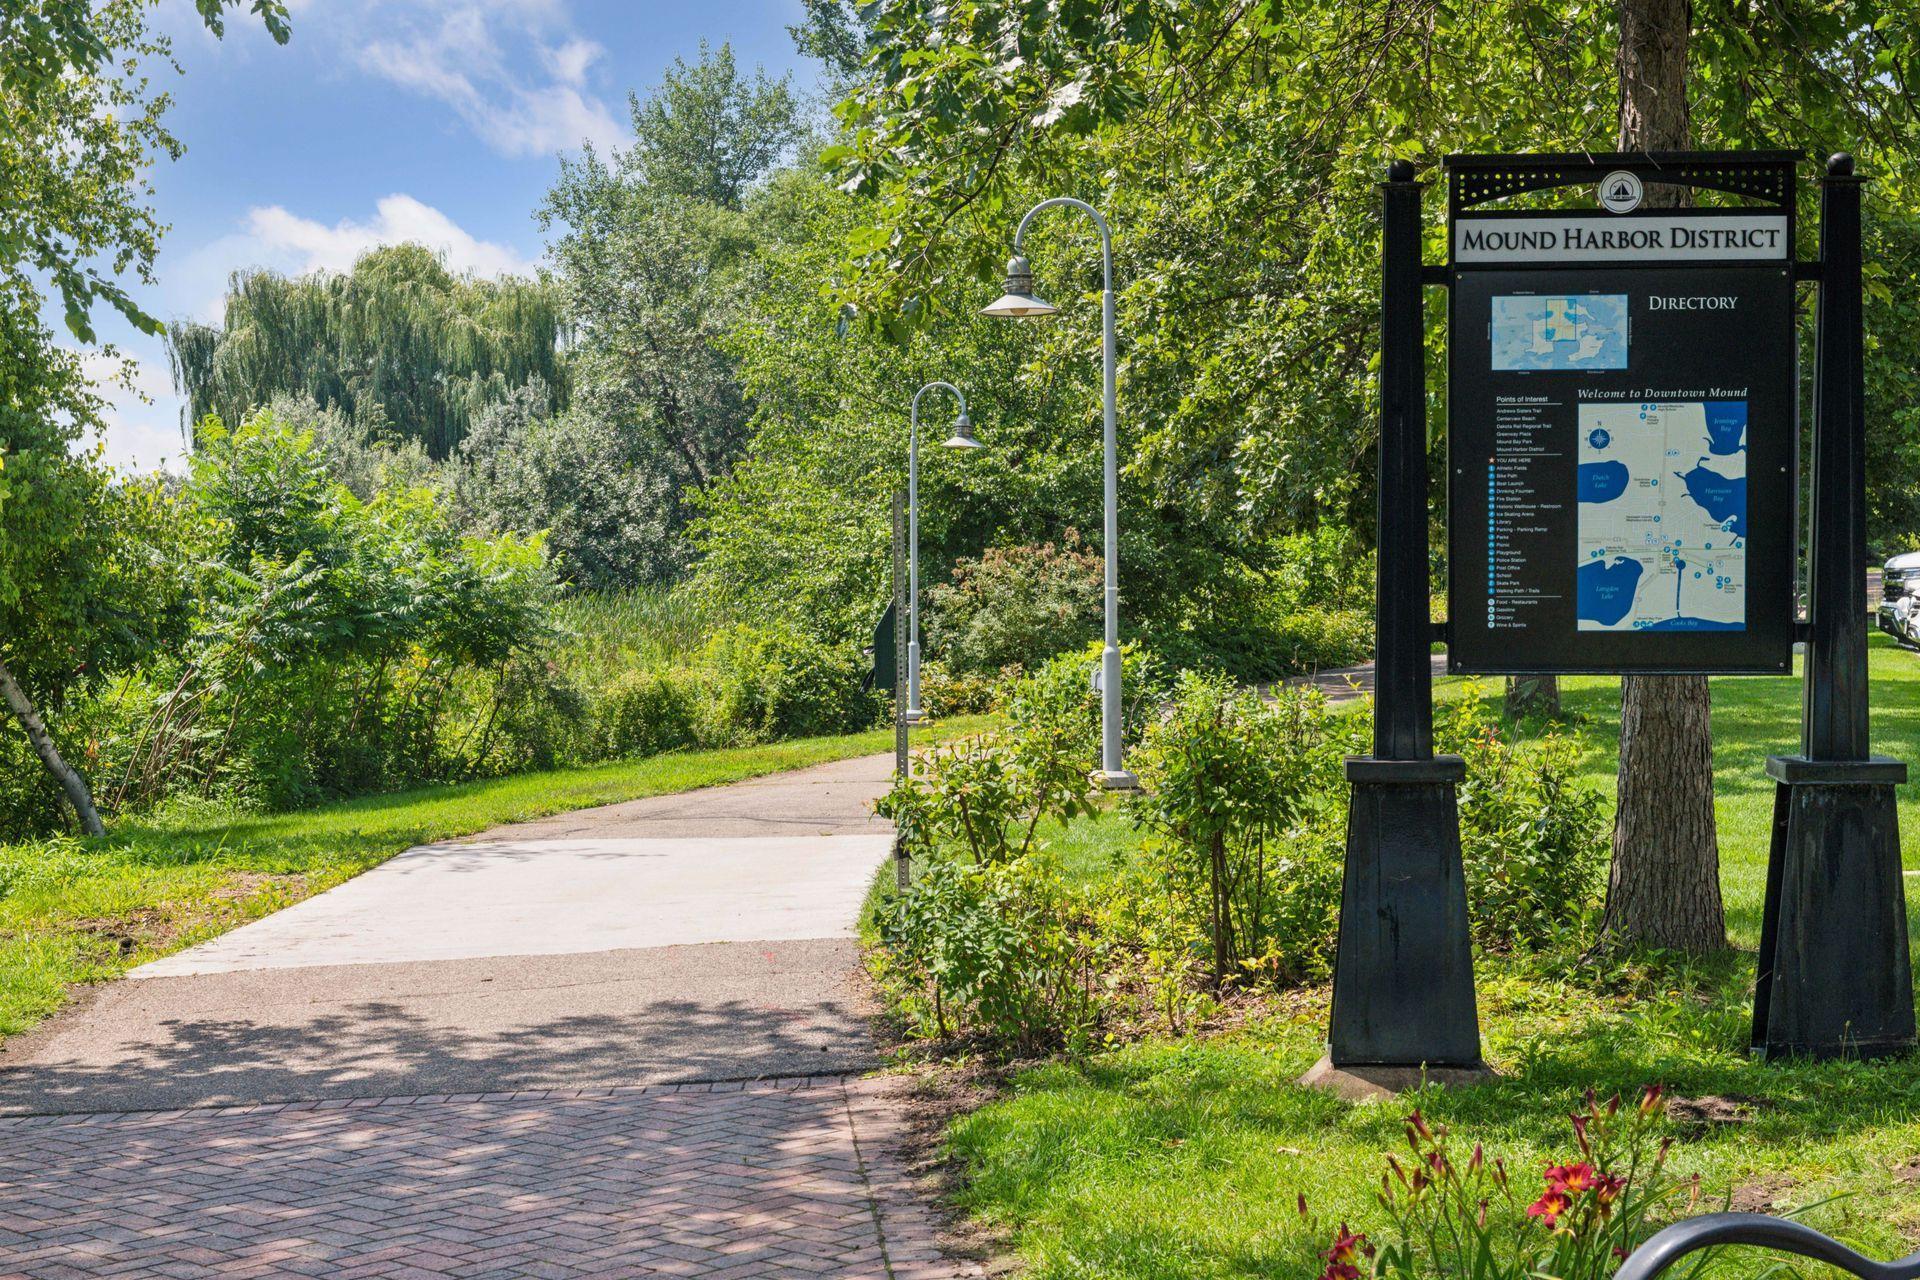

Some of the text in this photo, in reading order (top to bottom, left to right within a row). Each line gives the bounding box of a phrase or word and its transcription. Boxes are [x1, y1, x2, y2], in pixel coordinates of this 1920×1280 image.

[1463, 227, 1780, 251] MOUND HARBOR DISTRICT
[1649, 296, 1738, 310] DIRECTORY
[1578, 388, 1748, 399] Welcome to Downtown Mound
